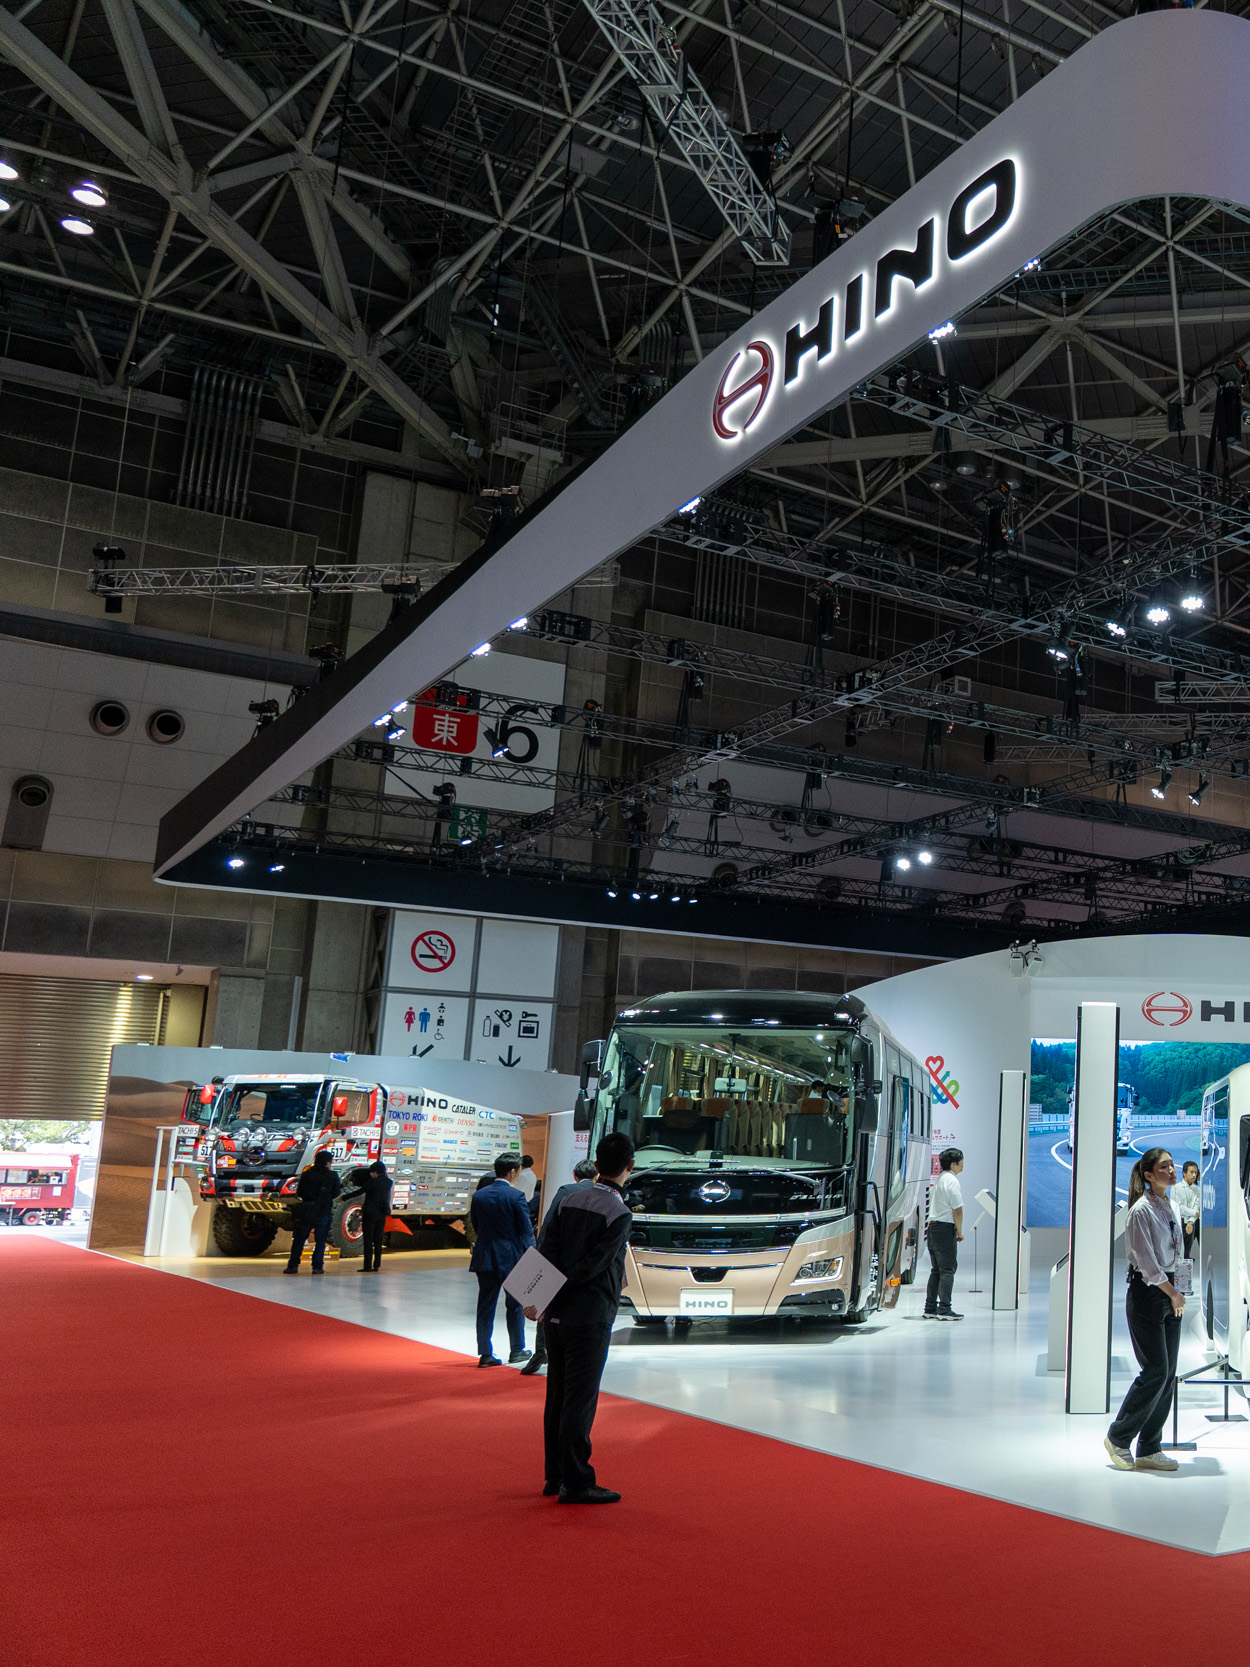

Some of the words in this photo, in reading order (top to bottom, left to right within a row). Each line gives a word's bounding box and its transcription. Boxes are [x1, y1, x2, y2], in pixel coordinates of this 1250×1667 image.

[784, 158, 1017, 388] HINO
[431, 713, 462, 747] 東
[498, 704, 540, 764] 6
[407, 1095, 448, 1109] HINO
[452, 1104, 476, 1115] CATALER
[478, 1110, 495, 1120] CTC
[388, 1110, 411, 1121] TOKYO
[412, 1113, 428, 1122] ROKI
[403, 1123, 418, 1132] NPR
[457, 1119, 475, 1127] DENSO
[685, 1300, 728, 1308] HINO
